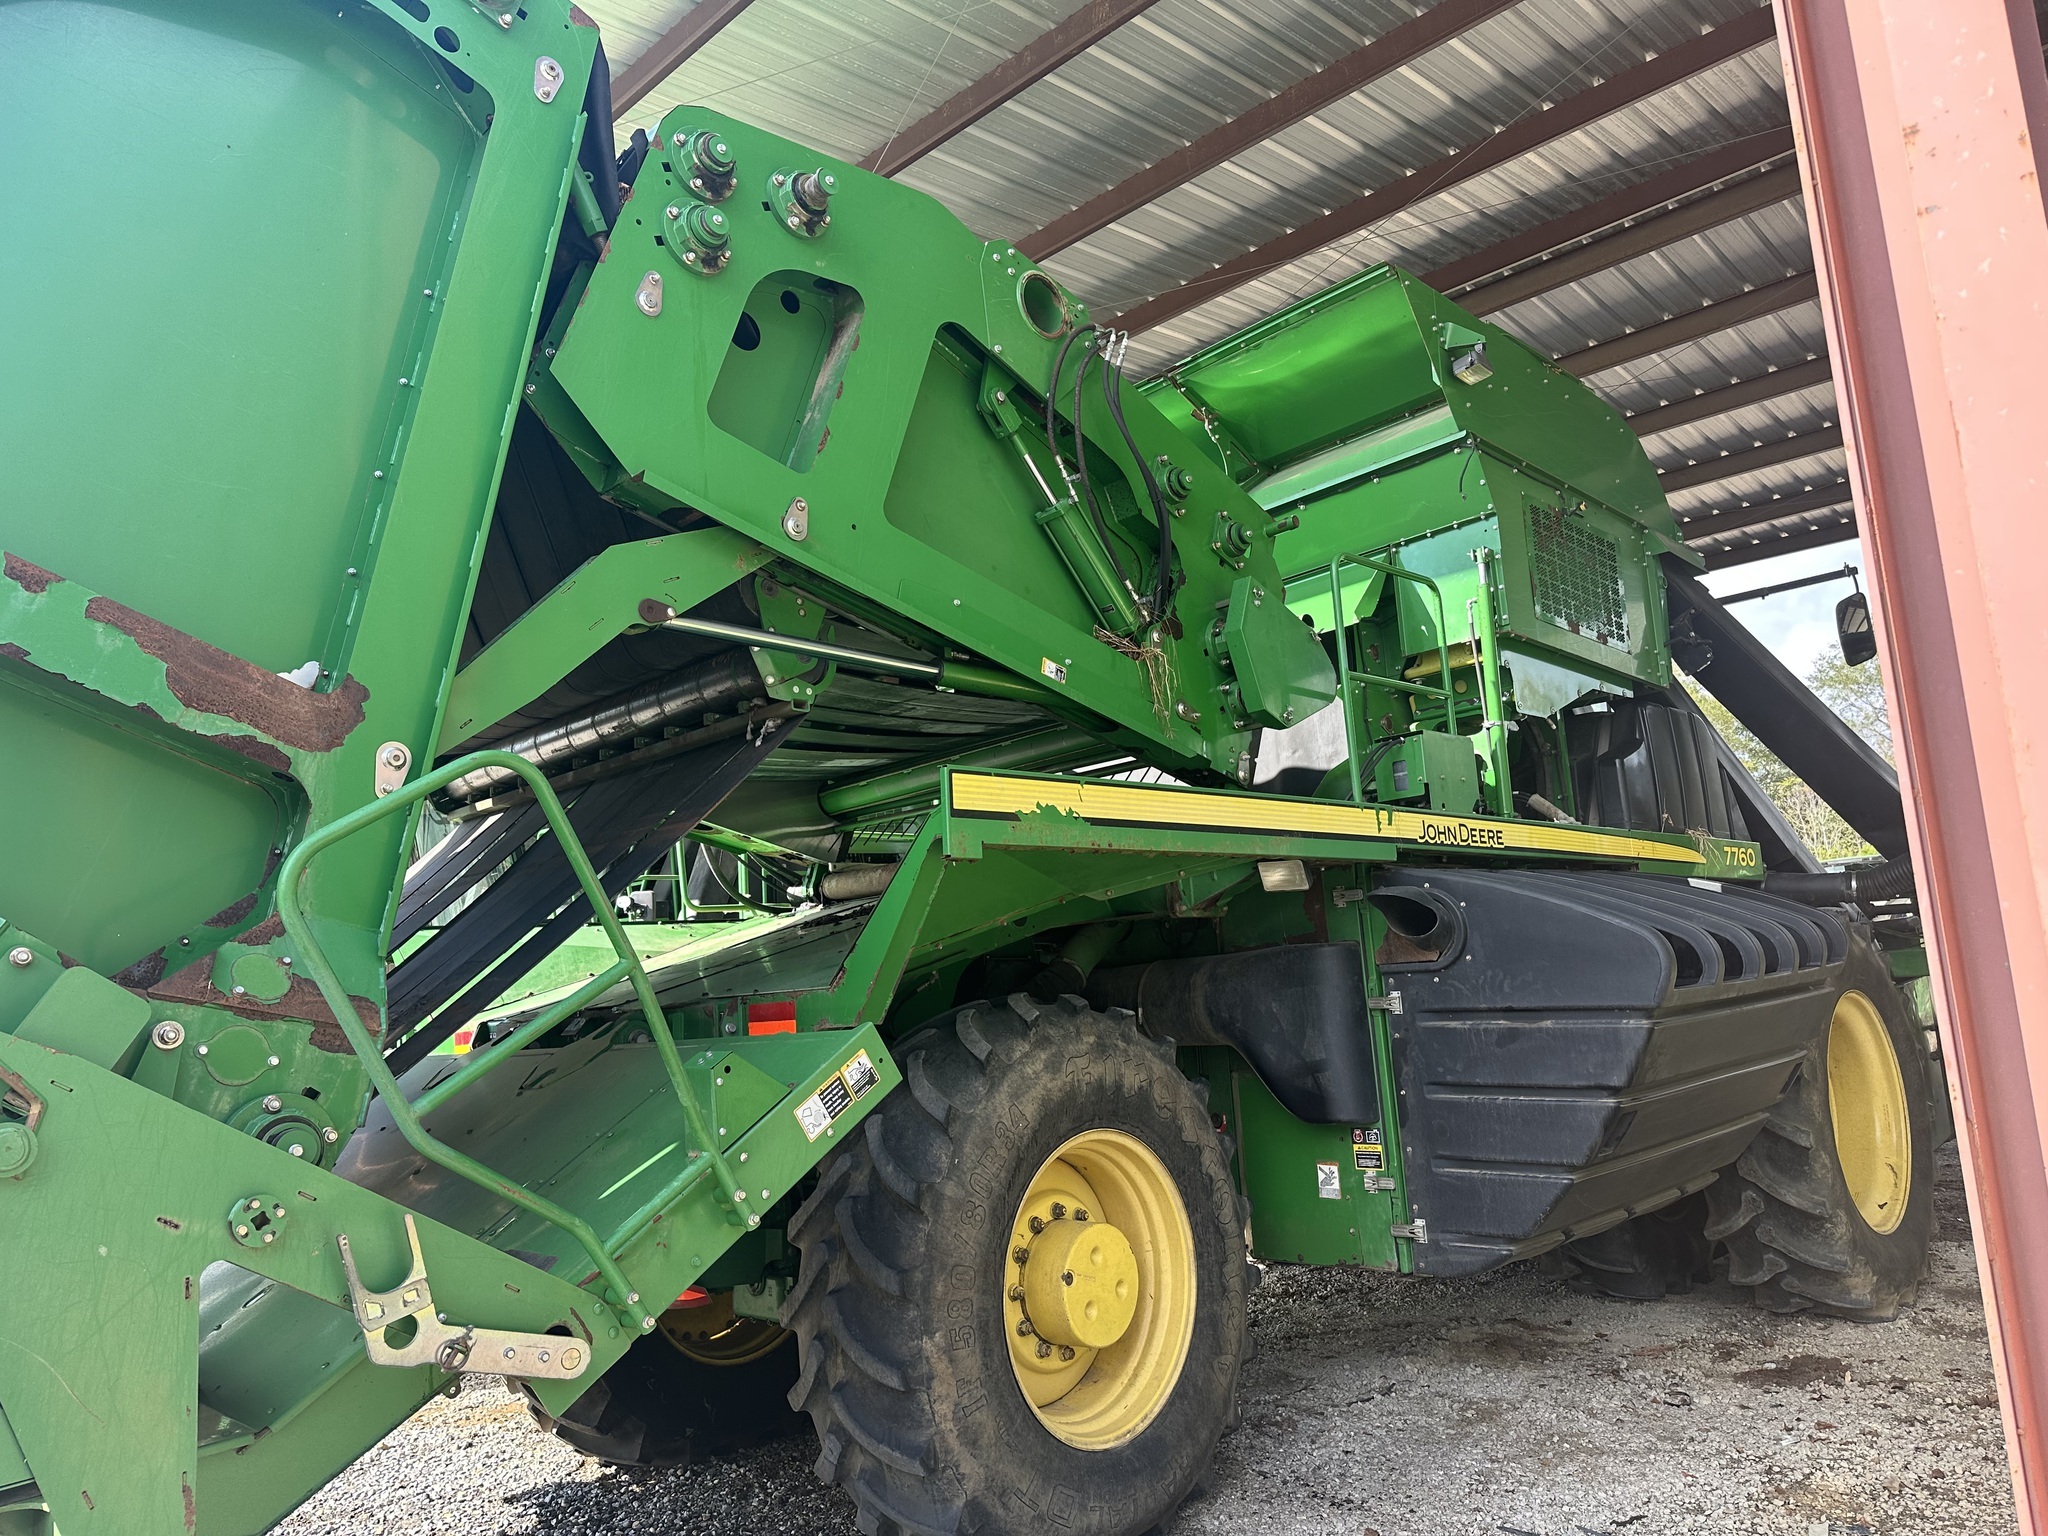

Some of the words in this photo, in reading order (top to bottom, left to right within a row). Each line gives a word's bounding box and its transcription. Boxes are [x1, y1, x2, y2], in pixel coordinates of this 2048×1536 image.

[1418, 819, 1458, 842] JOHN
[1458, 823, 1505, 846] DEERE
[1723, 846, 1756, 867] 7760
